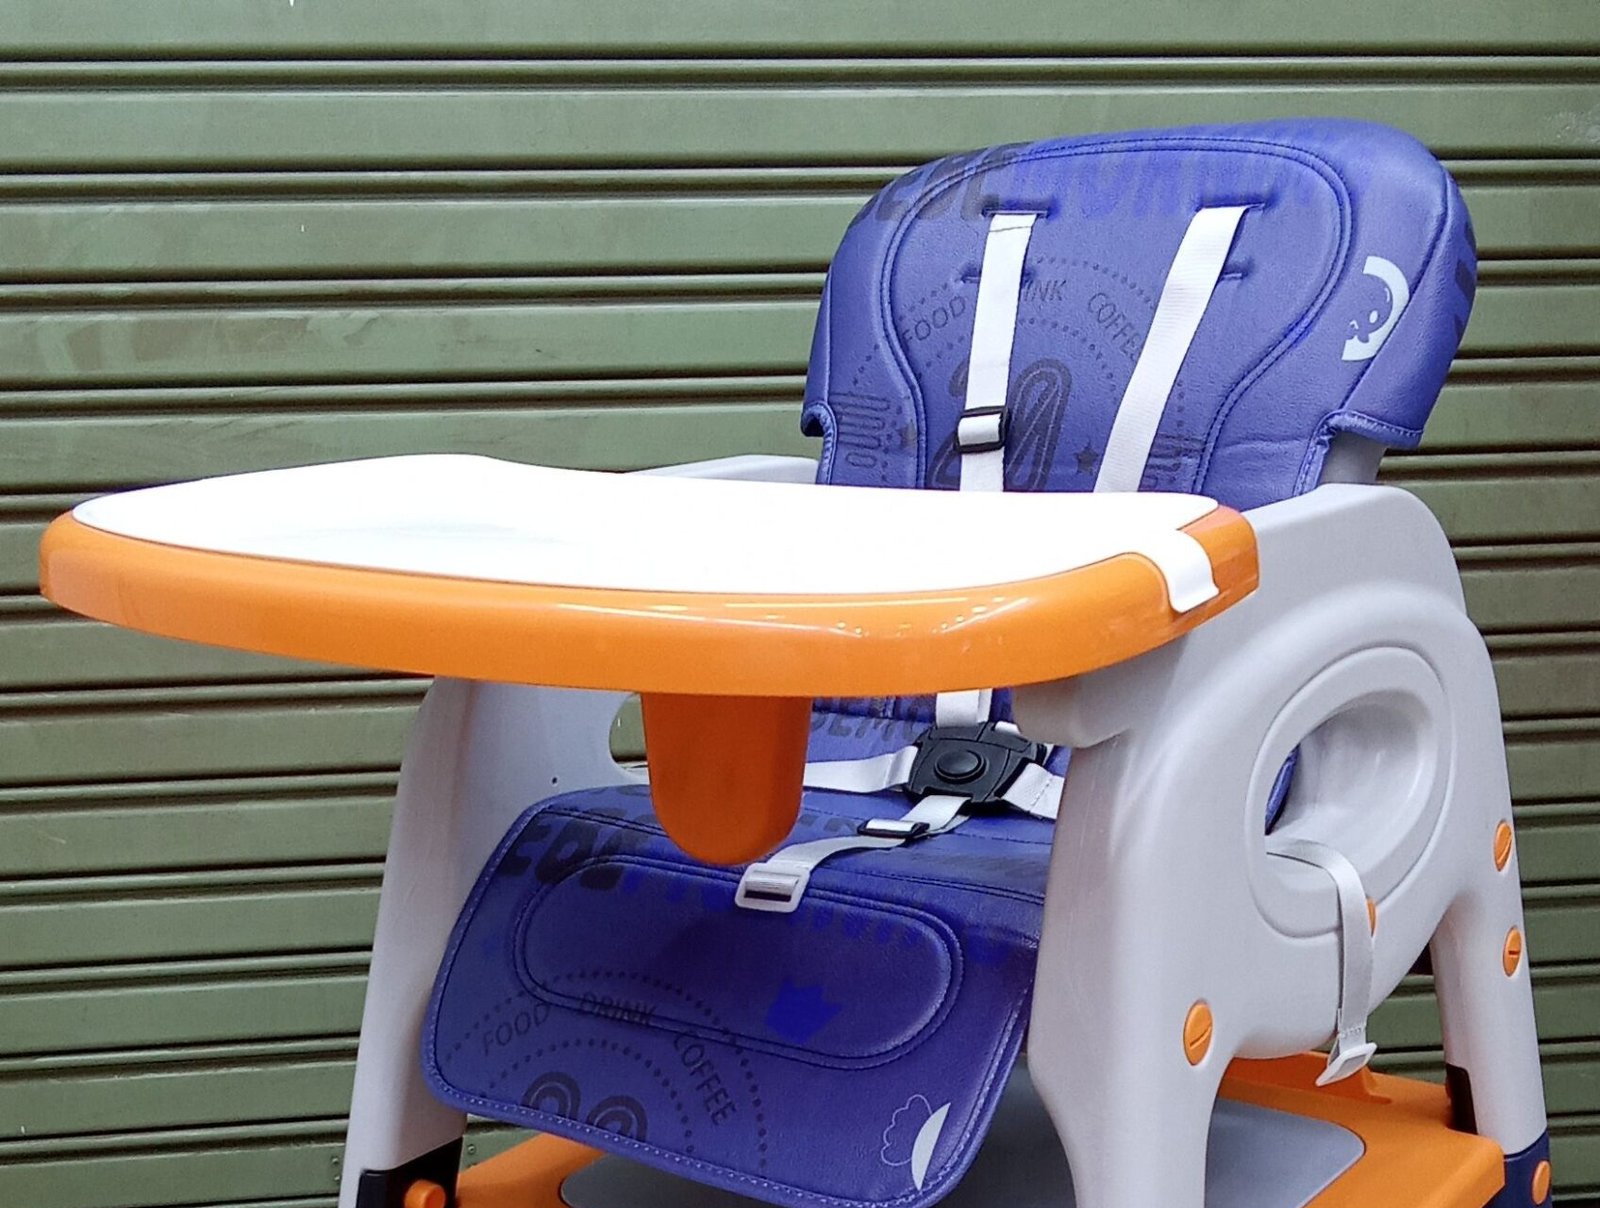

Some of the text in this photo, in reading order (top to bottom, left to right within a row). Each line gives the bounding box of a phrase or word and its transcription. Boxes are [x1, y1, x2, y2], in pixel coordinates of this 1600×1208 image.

[901, 279, 1142, 361] FOOD INK COFFE
[482, 991, 738, 1127] FOOD DRINK COFFEE
